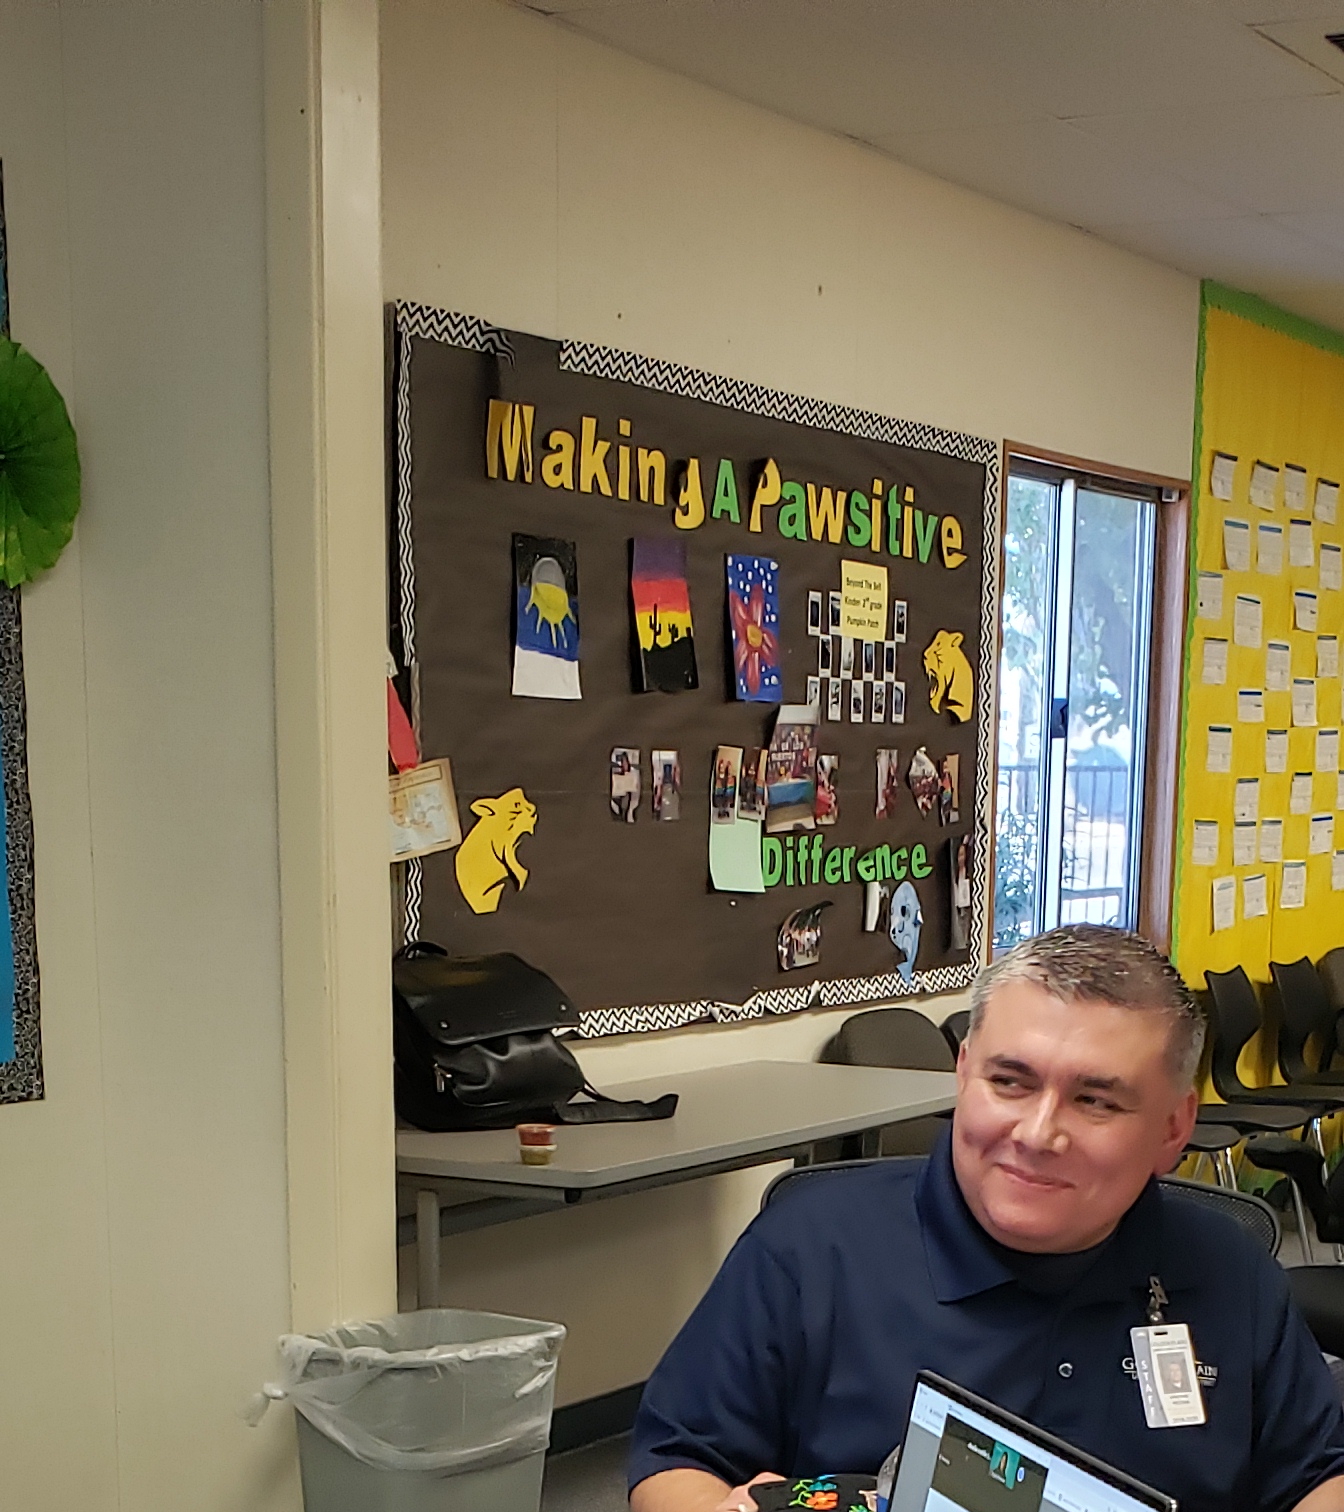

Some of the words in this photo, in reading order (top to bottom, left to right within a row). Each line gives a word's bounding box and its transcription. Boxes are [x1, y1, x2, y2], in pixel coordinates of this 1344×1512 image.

[486, 399, 707, 530] Making
[712, 458, 741, 524] A
[748, 457, 967, 570] Pawsitive
[762, 835, 934, 887] Difference
[1140, 1360, 1155, 1418] STAFF
